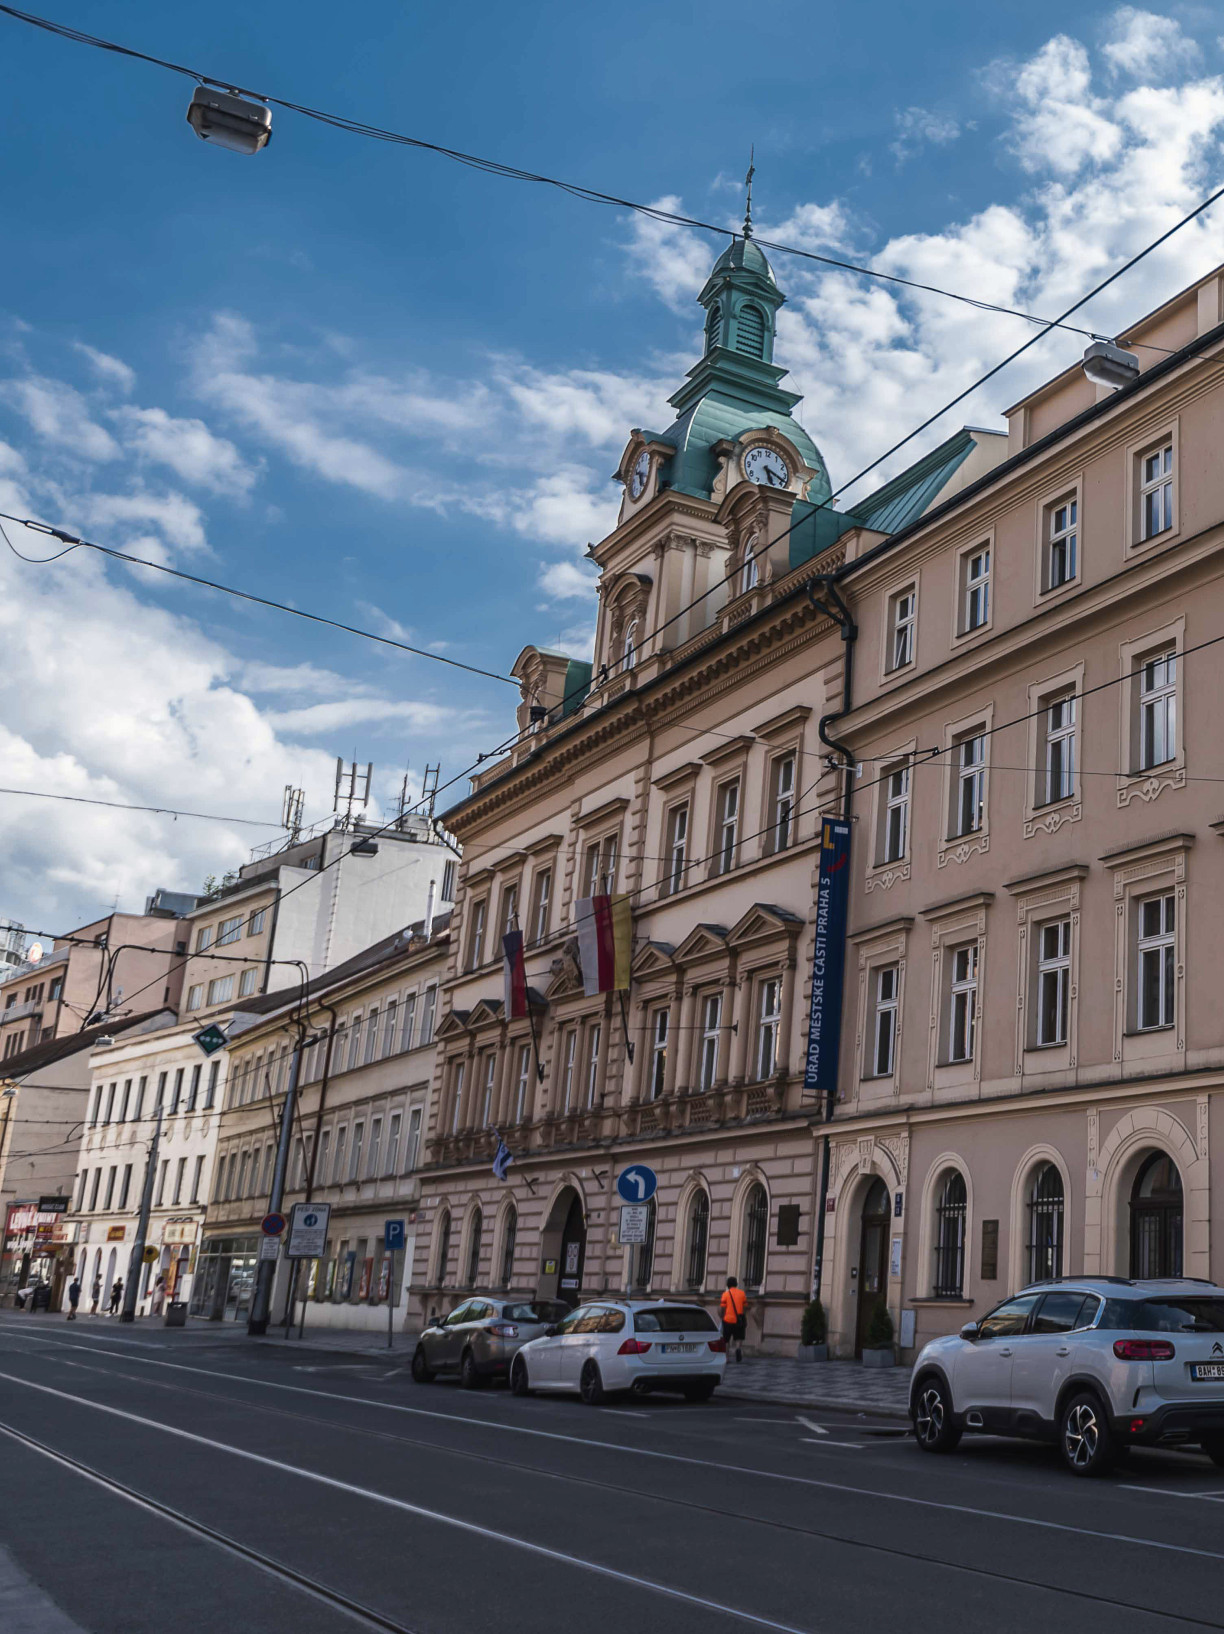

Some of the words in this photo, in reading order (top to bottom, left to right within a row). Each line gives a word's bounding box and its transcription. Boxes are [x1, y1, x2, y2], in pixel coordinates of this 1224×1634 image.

[757, 450, 762, 458] 11
[765, 450, 772, 458] 12
[780, 463, 785, 471] 2
[783, 472, 787, 480] 3
[820, 877, 830, 886] 5
[817, 889, 830, 933] PRAHA
[389, 1223, 400, 1241] P
[1197, 1366, 1212, 1376] 8AH
